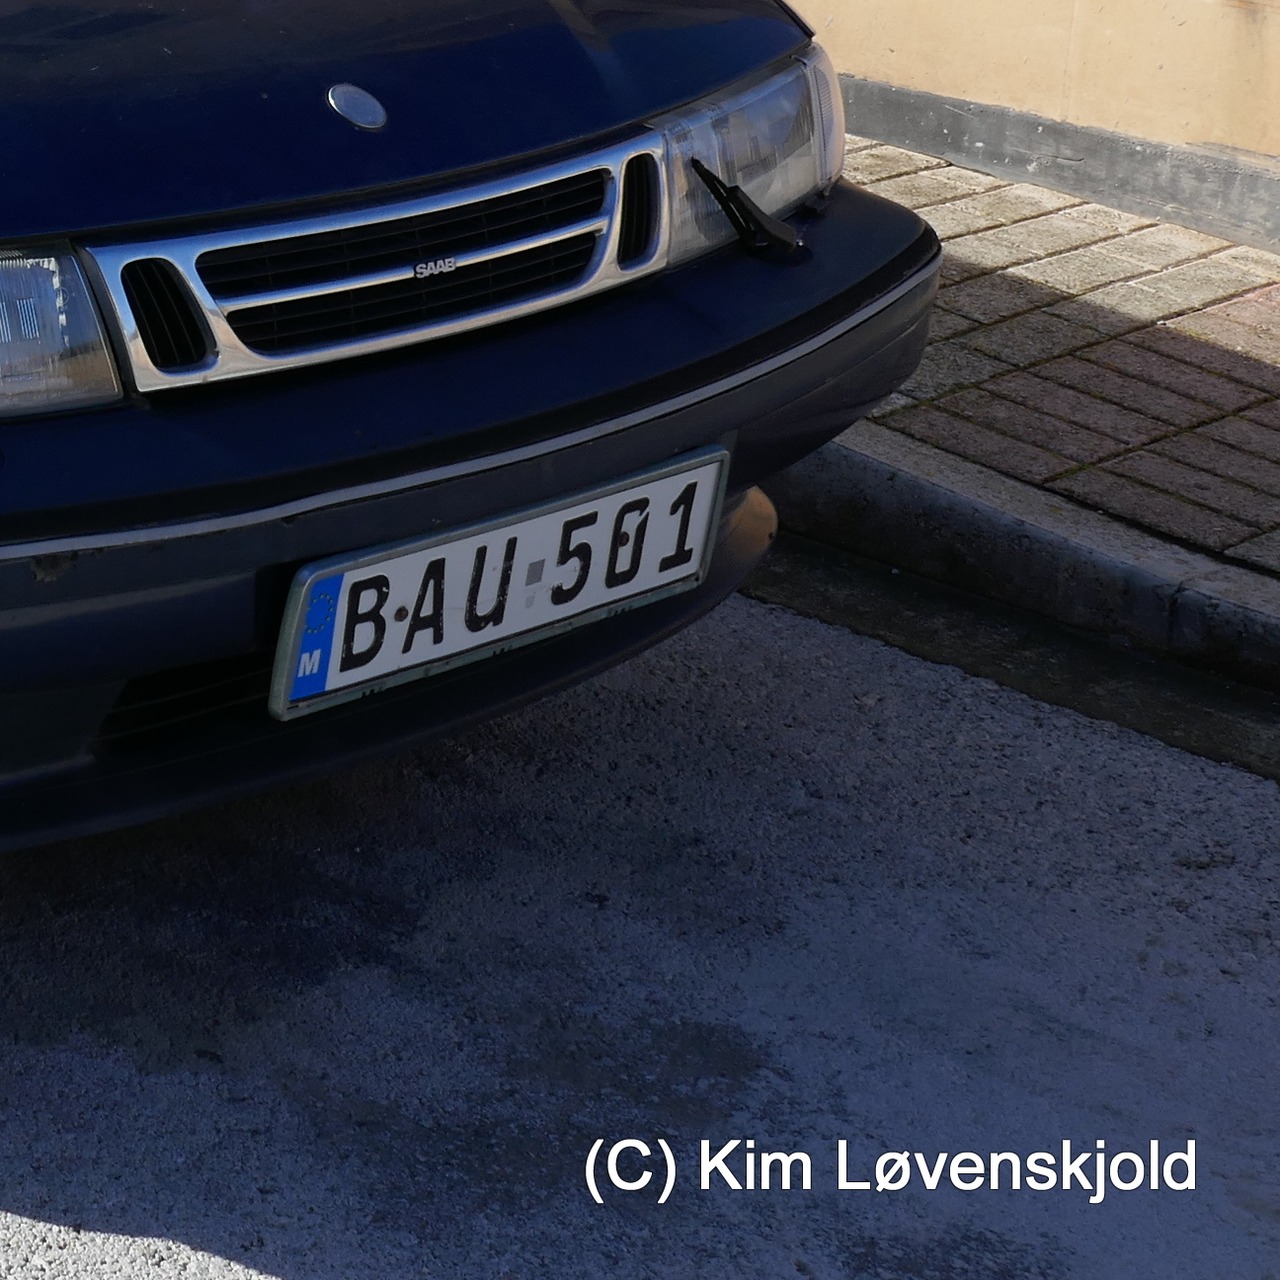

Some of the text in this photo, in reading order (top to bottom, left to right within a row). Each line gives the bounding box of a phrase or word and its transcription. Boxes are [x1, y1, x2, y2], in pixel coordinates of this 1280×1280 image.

[415, 257, 456, 279] SAAB
[339, 480, 698, 673] BAU 501
[297, 648, 322, 678] M
